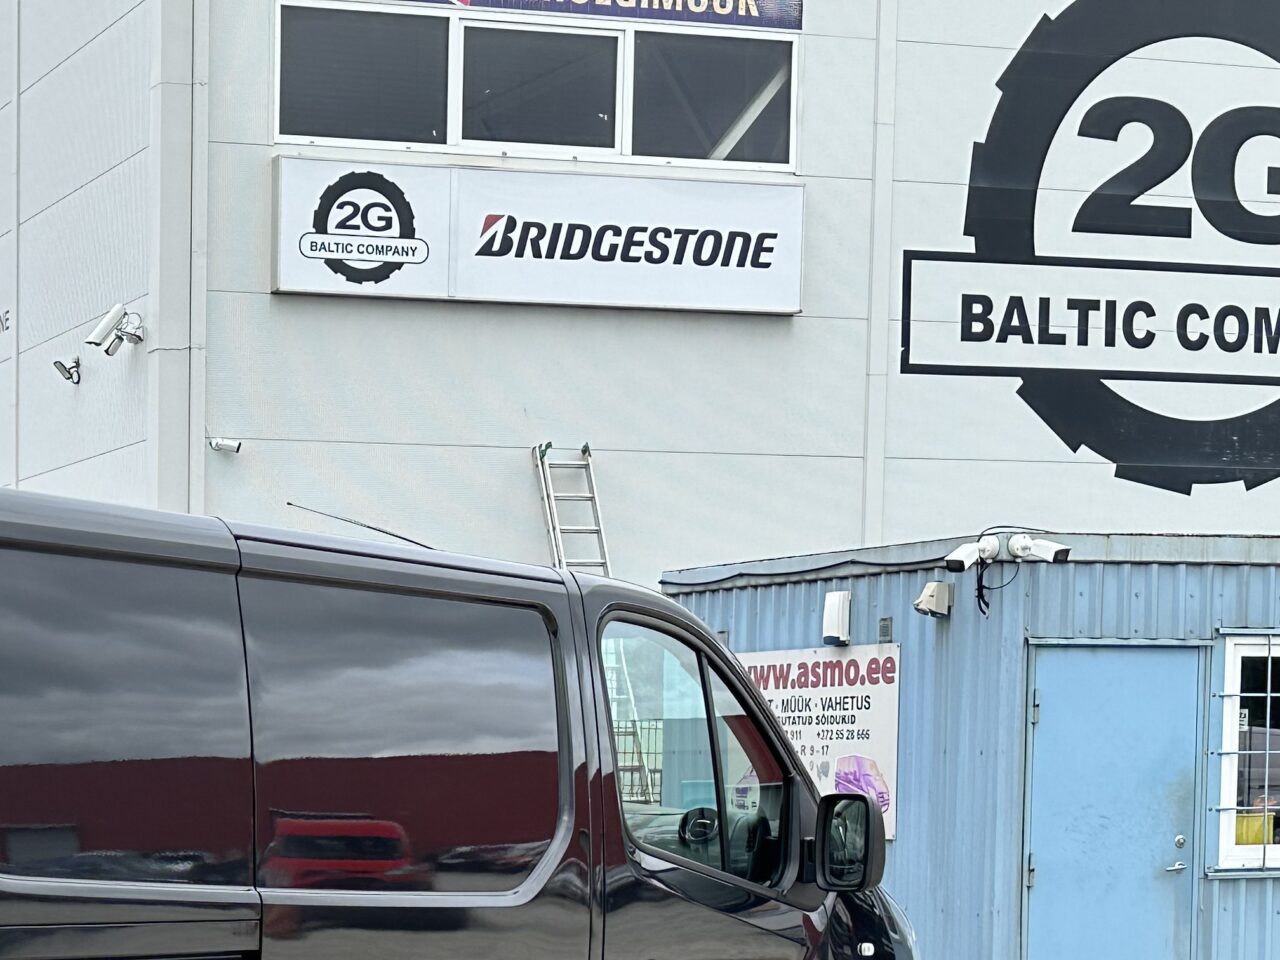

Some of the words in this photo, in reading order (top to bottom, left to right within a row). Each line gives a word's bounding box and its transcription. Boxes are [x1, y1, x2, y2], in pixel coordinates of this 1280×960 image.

[1071, 96, 1280, 245] 2G
[334, 200, 393, 232] 2G
[310, 241, 354, 254] BALTIC
[356, 243, 418, 257] COMPANY
[474, 213, 779, 269] BRIDGESTONE
[959, 293, 1157, 349] BALTIC
[1175, 302, 1280, 355] COM
[781, 695, 812, 713] MÜÜK
[820, 695, 871, 712] VAHETUS
